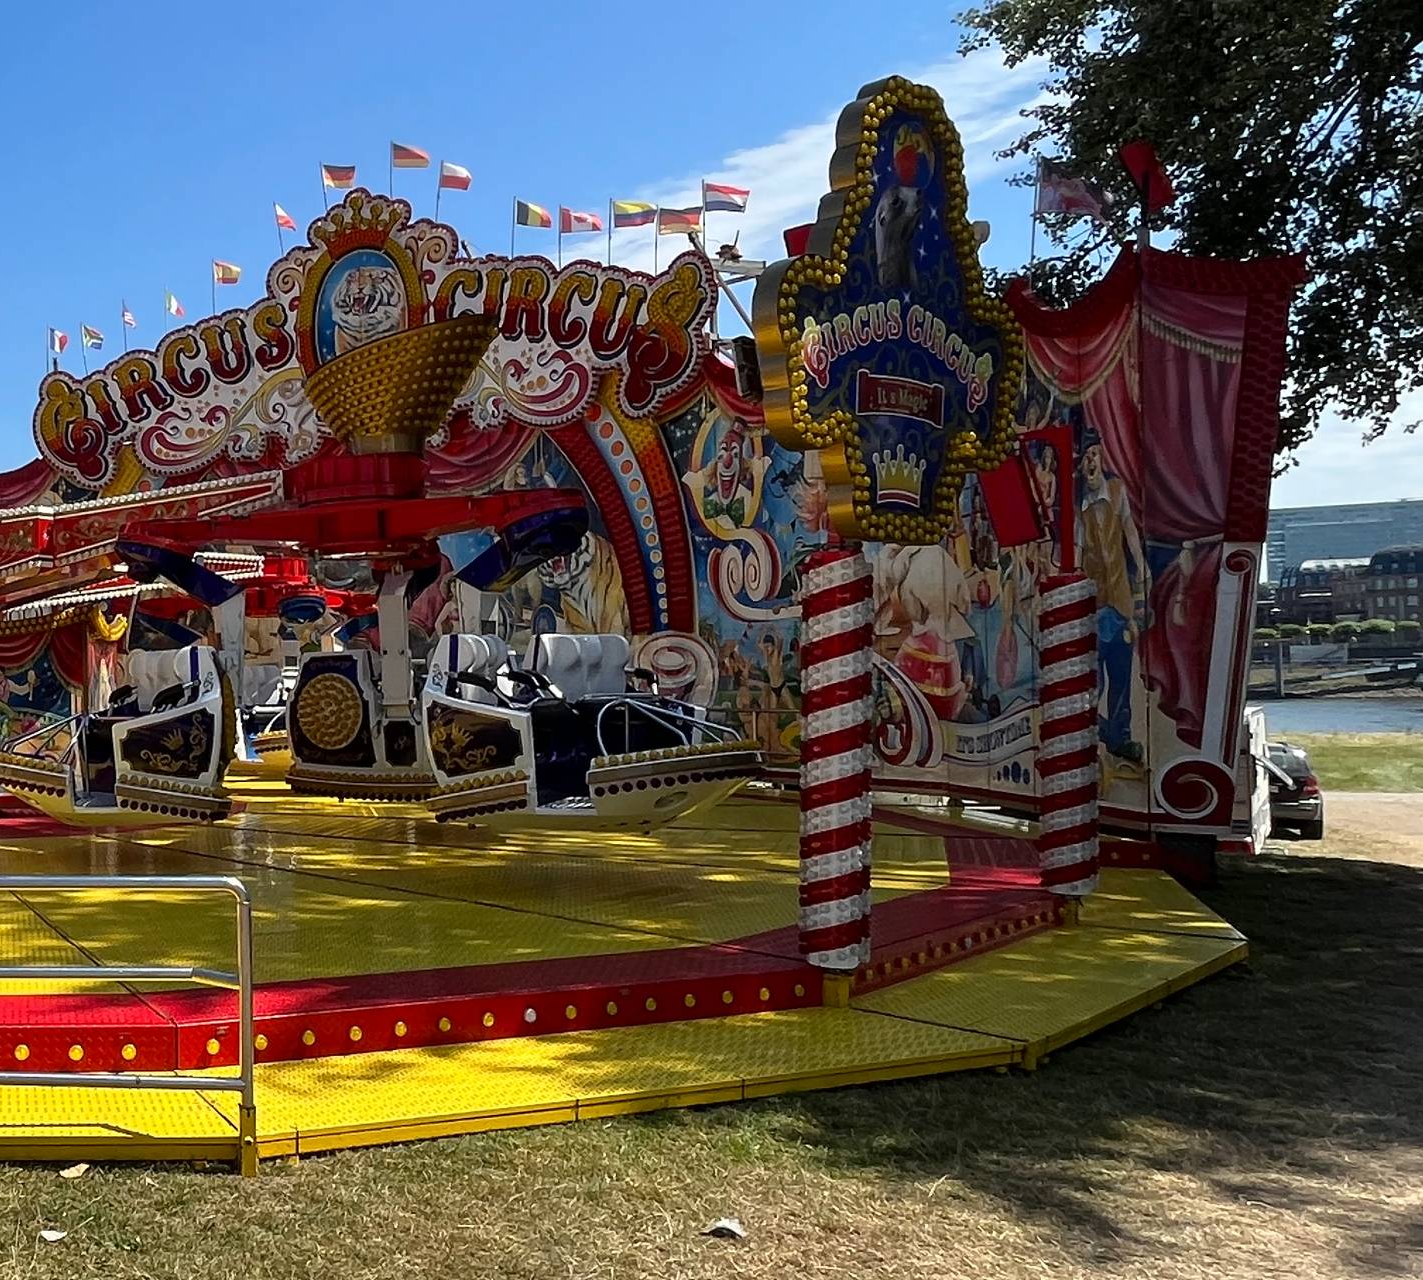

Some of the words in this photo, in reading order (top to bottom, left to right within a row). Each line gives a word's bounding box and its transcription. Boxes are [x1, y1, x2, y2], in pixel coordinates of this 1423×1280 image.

[40, 303, 292, 479] CIRCUS
[434, 263, 706, 411] CIRCUS
[801, 299, 903, 388] CIRCUS
[907, 304, 993, 413] CIRCUS
